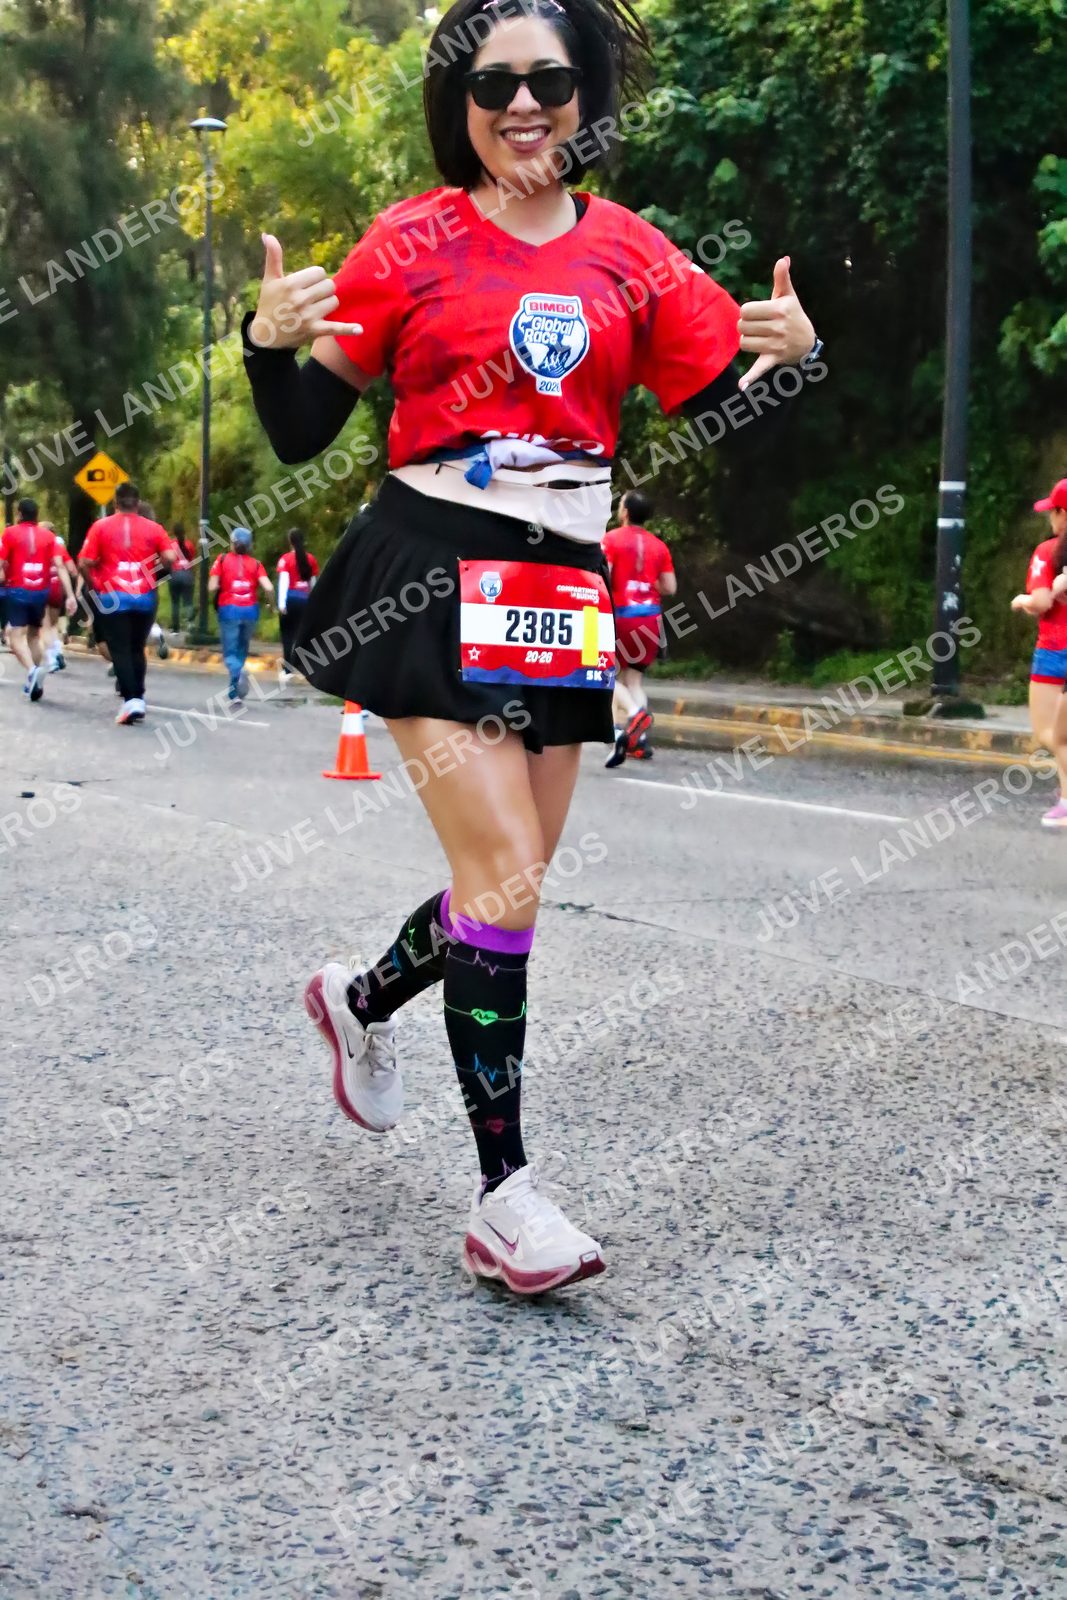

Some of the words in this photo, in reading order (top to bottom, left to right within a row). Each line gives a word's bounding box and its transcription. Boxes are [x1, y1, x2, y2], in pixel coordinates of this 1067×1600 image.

[529, 301, 576, 315] BIMBO
[532, 316, 574, 336] Global
[524, 328, 558, 346] Race
[505, 609, 573, 646] 2385
[586, 669, 603, 681] 5K
